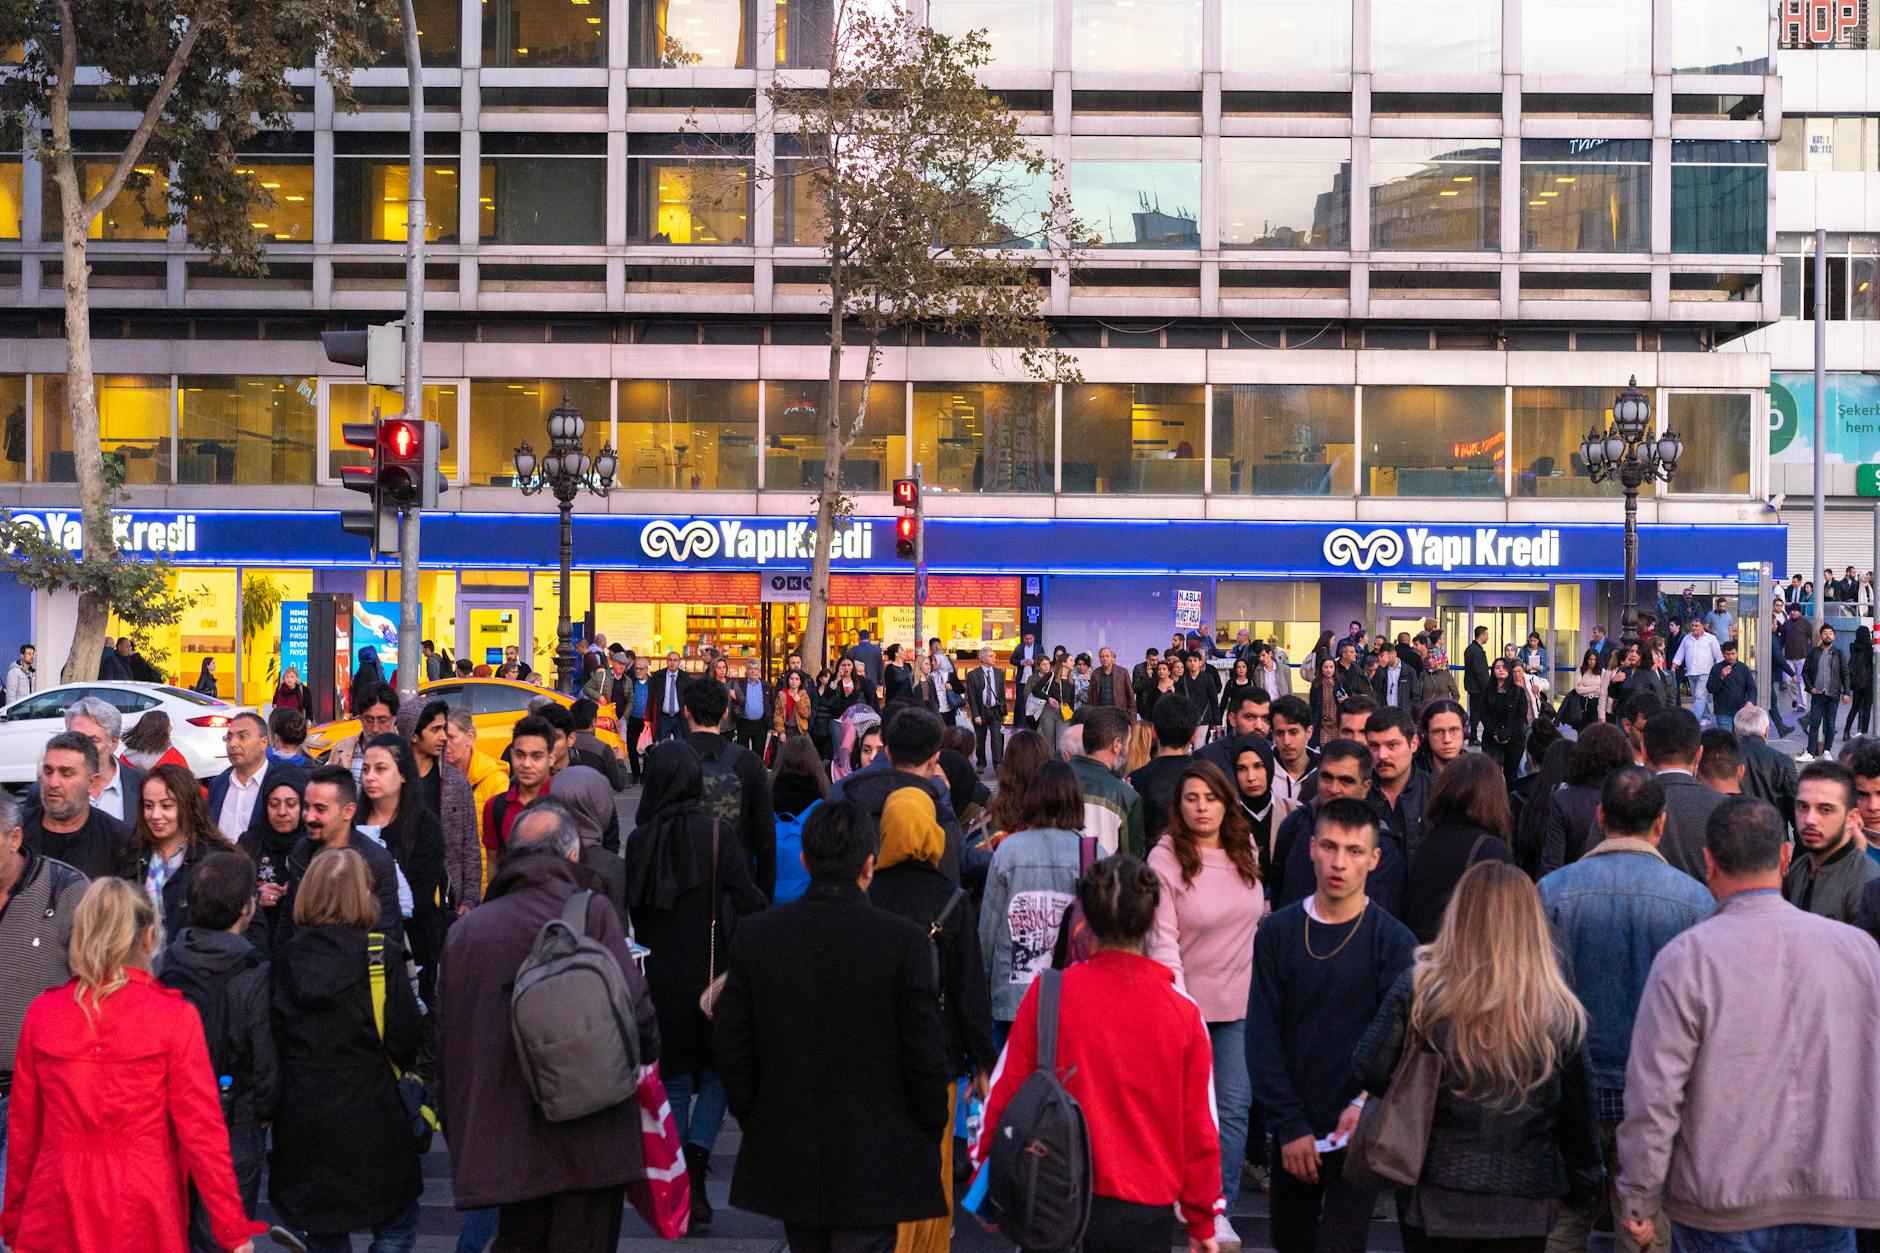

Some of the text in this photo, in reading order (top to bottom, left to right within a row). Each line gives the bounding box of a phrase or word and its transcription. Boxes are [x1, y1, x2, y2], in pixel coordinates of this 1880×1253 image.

[1845, 421, 1874, 433] hem
[901, 484, 912, 501] 4
[1475, 528, 1560, 567] Kredi
